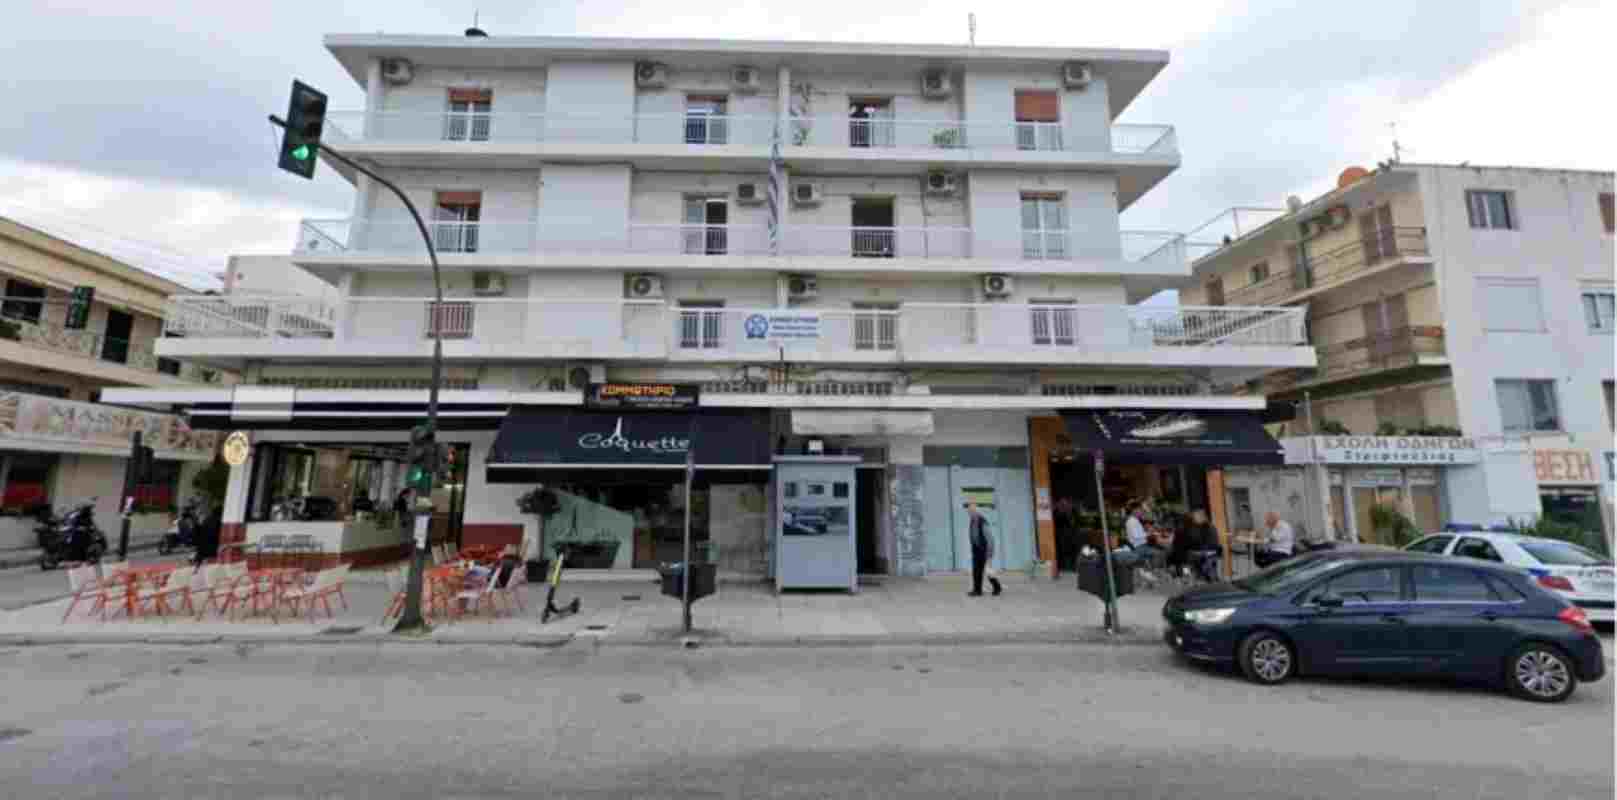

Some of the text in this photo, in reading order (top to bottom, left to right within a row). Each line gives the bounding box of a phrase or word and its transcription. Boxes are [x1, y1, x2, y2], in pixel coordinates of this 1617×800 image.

[578, 432, 690, 453] Coquette
[1324, 437, 1478, 450] ΣΧΟΛΗ ΟΔΗΓΩΝ
[1533, 449, 1595, 480] ΒΕΣΗ
